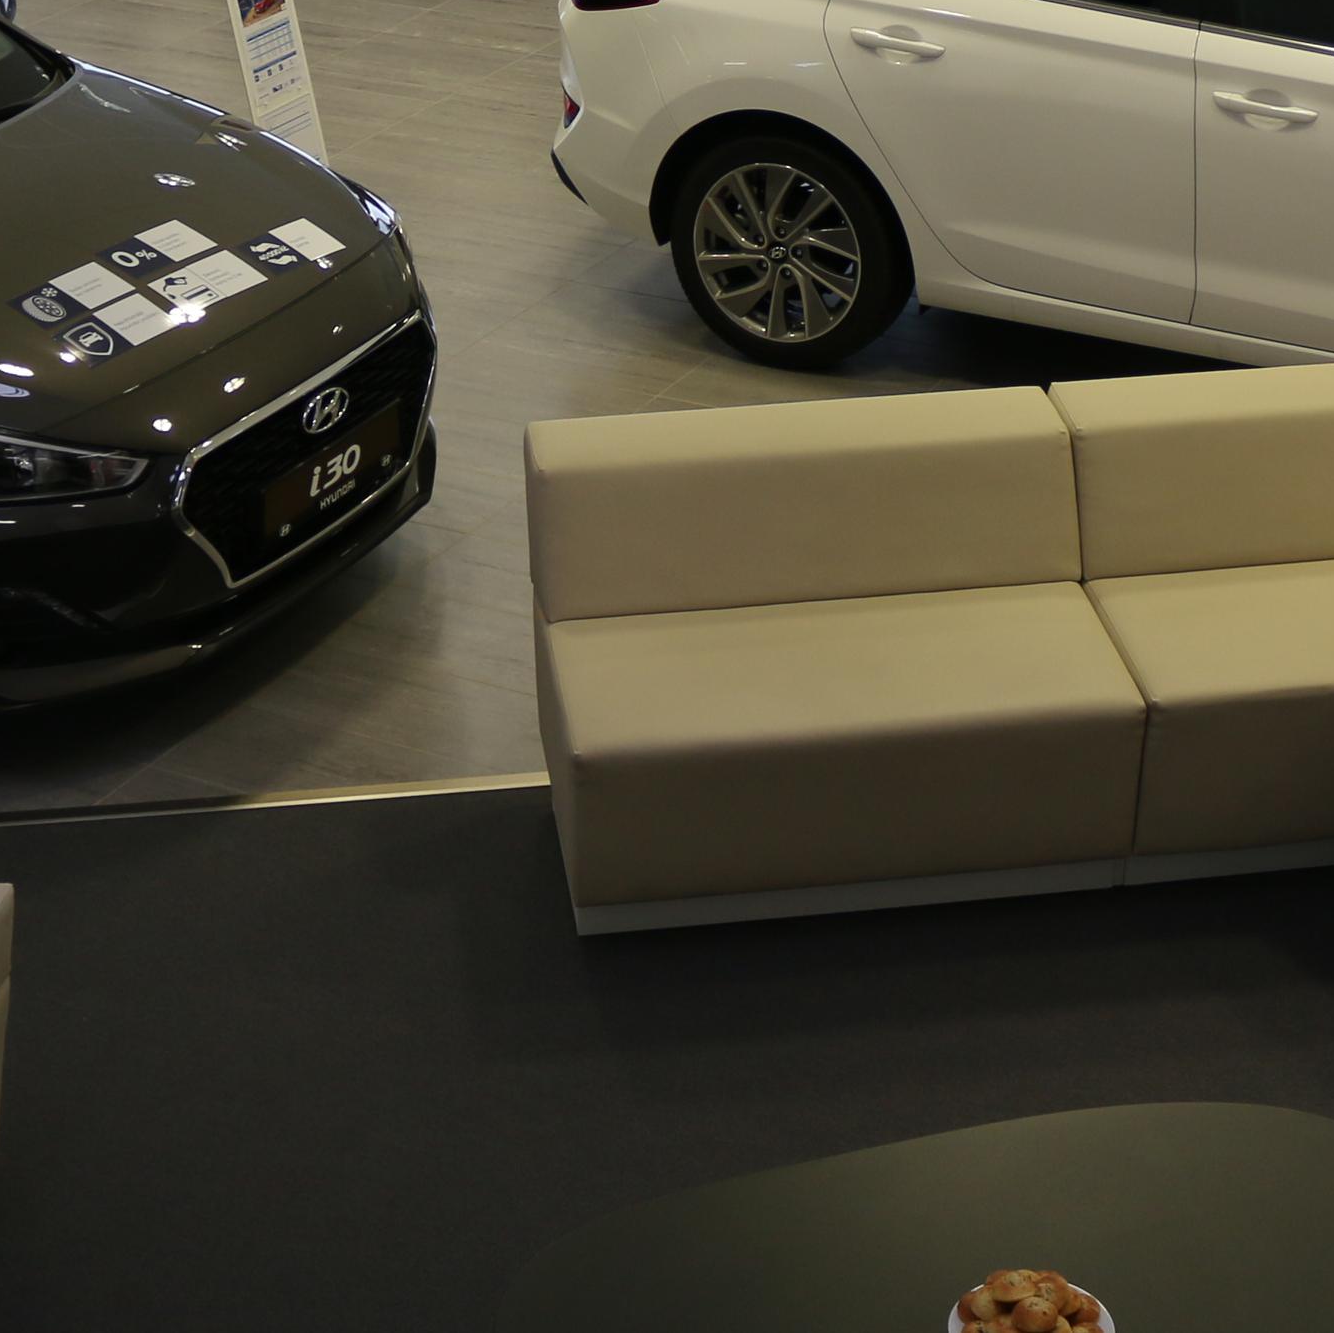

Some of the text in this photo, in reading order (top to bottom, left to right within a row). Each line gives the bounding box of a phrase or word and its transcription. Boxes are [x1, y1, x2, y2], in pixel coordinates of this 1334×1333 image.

[111, 249, 158, 267] 0%
[309, 444, 361, 497] i30
[319, 478, 356, 510] HYUNDAI
